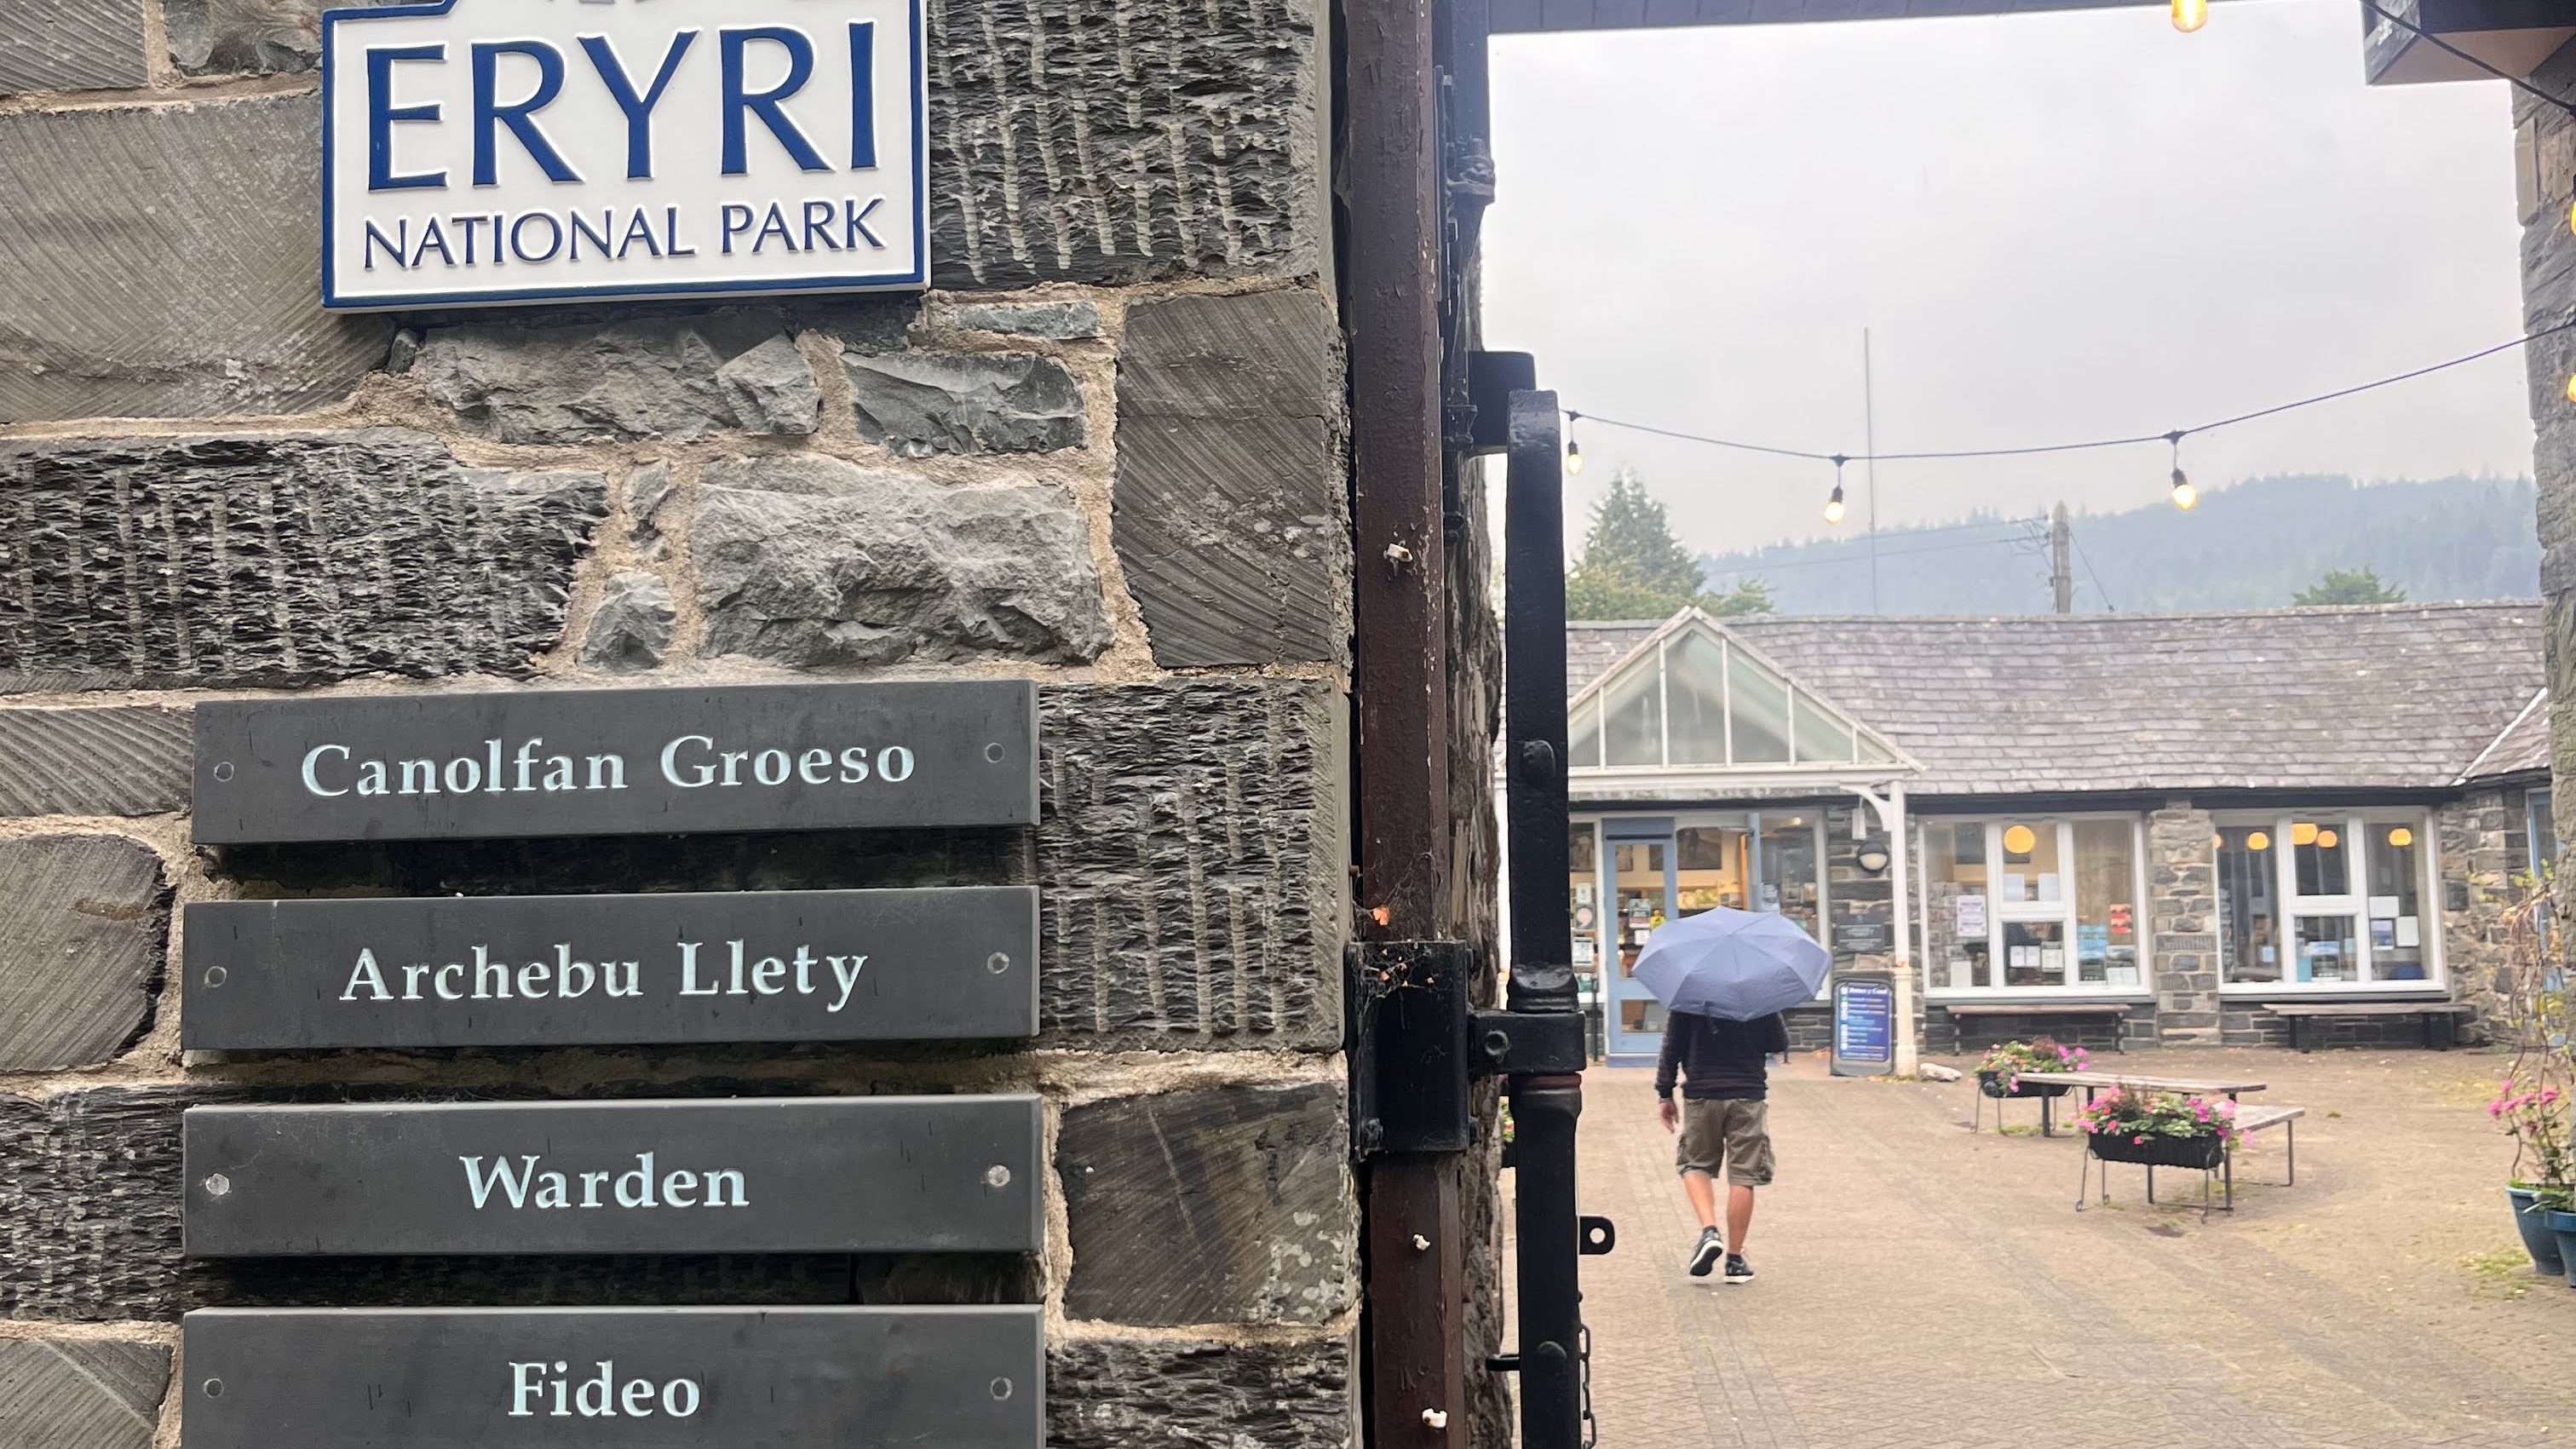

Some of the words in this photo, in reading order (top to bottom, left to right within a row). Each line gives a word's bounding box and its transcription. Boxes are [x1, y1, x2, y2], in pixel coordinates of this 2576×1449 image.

[366, 22, 876, 192] ERYRI
[365, 209, 695, 270] NATIONAL
[722, 199, 886, 255] PARK
[301, 737, 630, 797] Canolfan
[659, 733, 916, 789] Groeso
[338, 943, 645, 1001] Archebu
[676, 939, 869, 1012] Llety
[458, 1151, 750, 1210] Warden
[508, 1360, 701, 1418] Fideo
